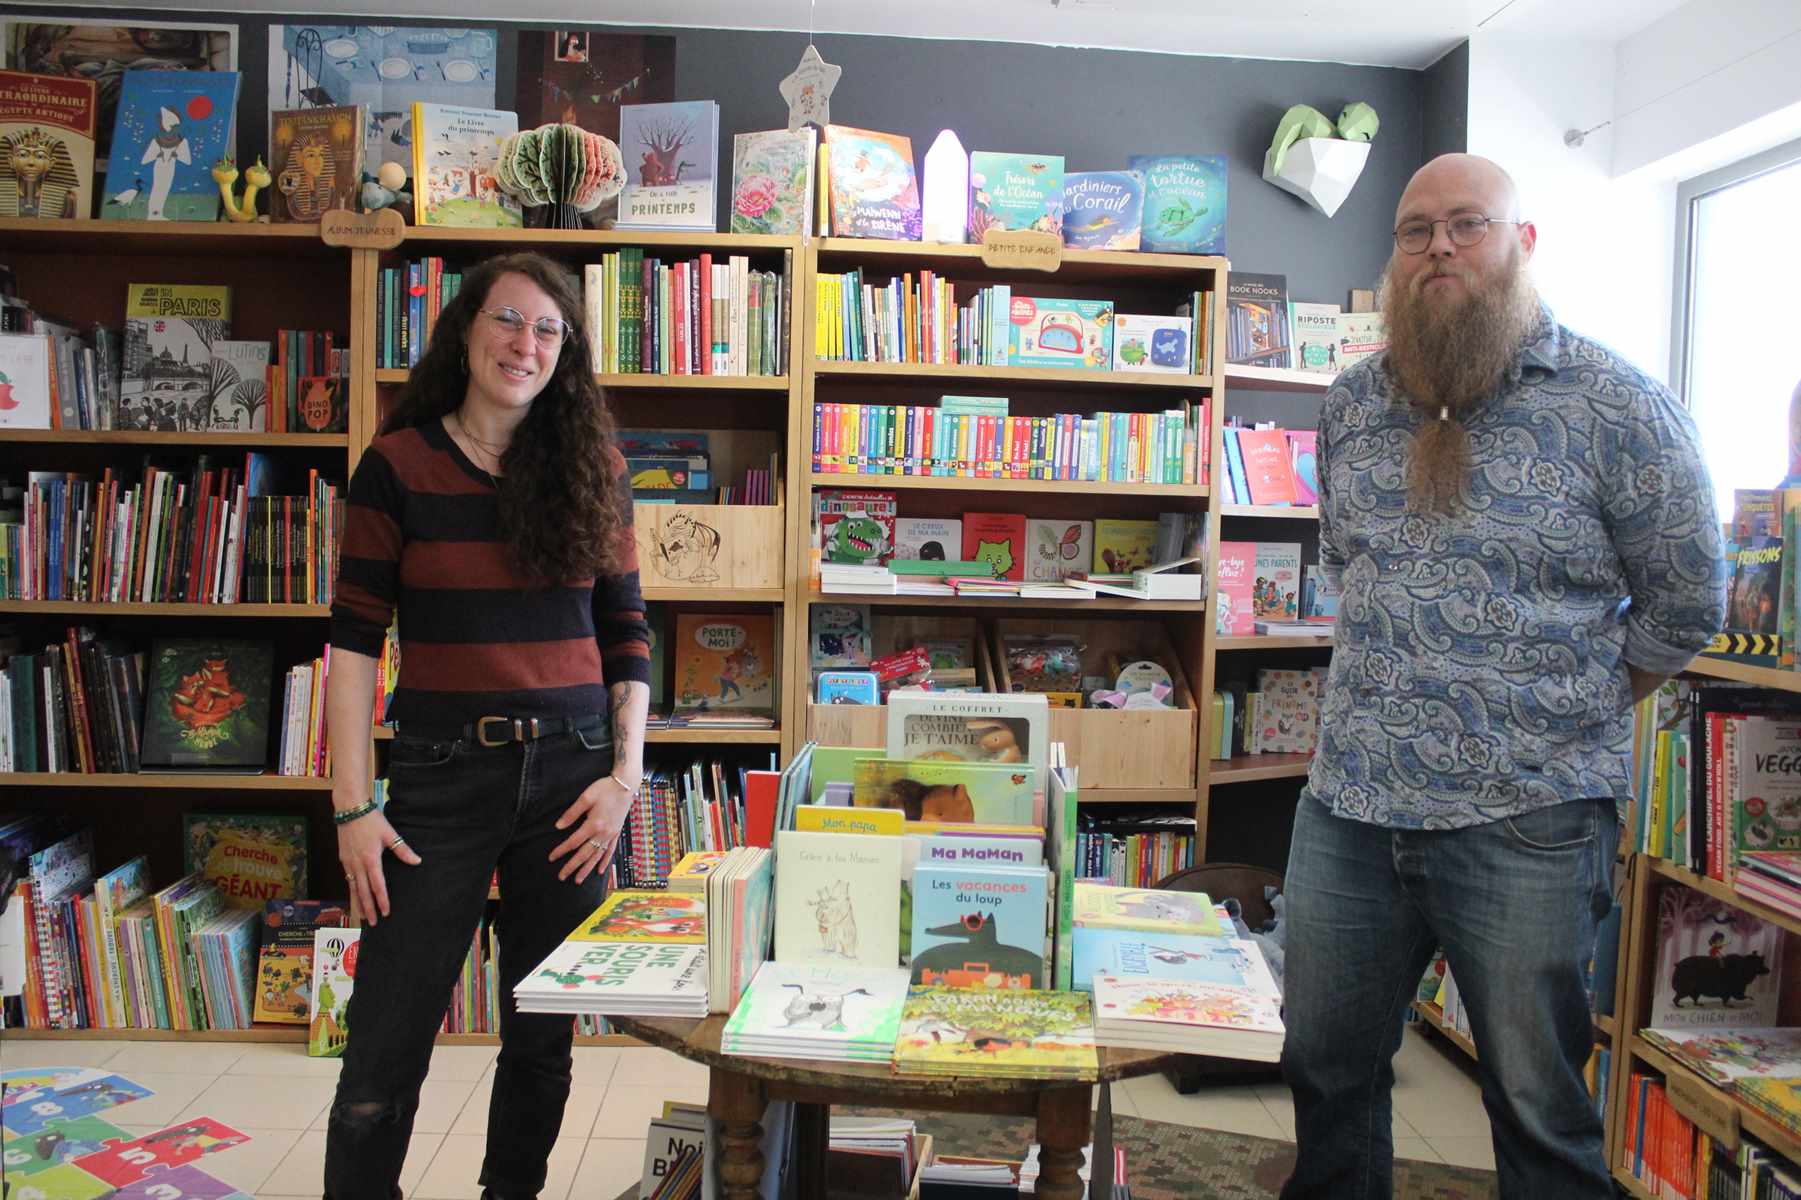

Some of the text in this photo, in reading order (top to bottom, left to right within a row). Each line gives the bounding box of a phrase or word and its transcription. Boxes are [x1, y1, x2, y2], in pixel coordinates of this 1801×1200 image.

[1152, 171, 1206, 188] tortue
[631, 202, 696, 215] PRINTEMPS
[1073, 193, 1131, 214] Corail
[1230, 286, 1280, 296] BOOK NOOKS
[159, 298, 222, 316] PARIS
[1297, 315, 1337, 325] RIPOSTE
[820, 501, 893, 513] dinosaure!
[1271, 559, 1298, 568] PARENTS
[952, 704, 1003, 713] COFFRET
[904, 733, 978, 746] JE T'AIME
[224, 845, 279, 864] Cherche
[931, 847, 956, 859] Ma
[214, 873, 283, 901] GÉANT
[932, 879, 1027, 893] Les vacances
[955, 892, 1003, 907] du loup
[647, 946, 689, 969] UNE
[594, 945, 649, 986] SOURIS
[1689, 1009, 1726, 1024] CHIEN
[31, 1102, 64, 1116] 8
[117, 1147, 157, 1165] 5
